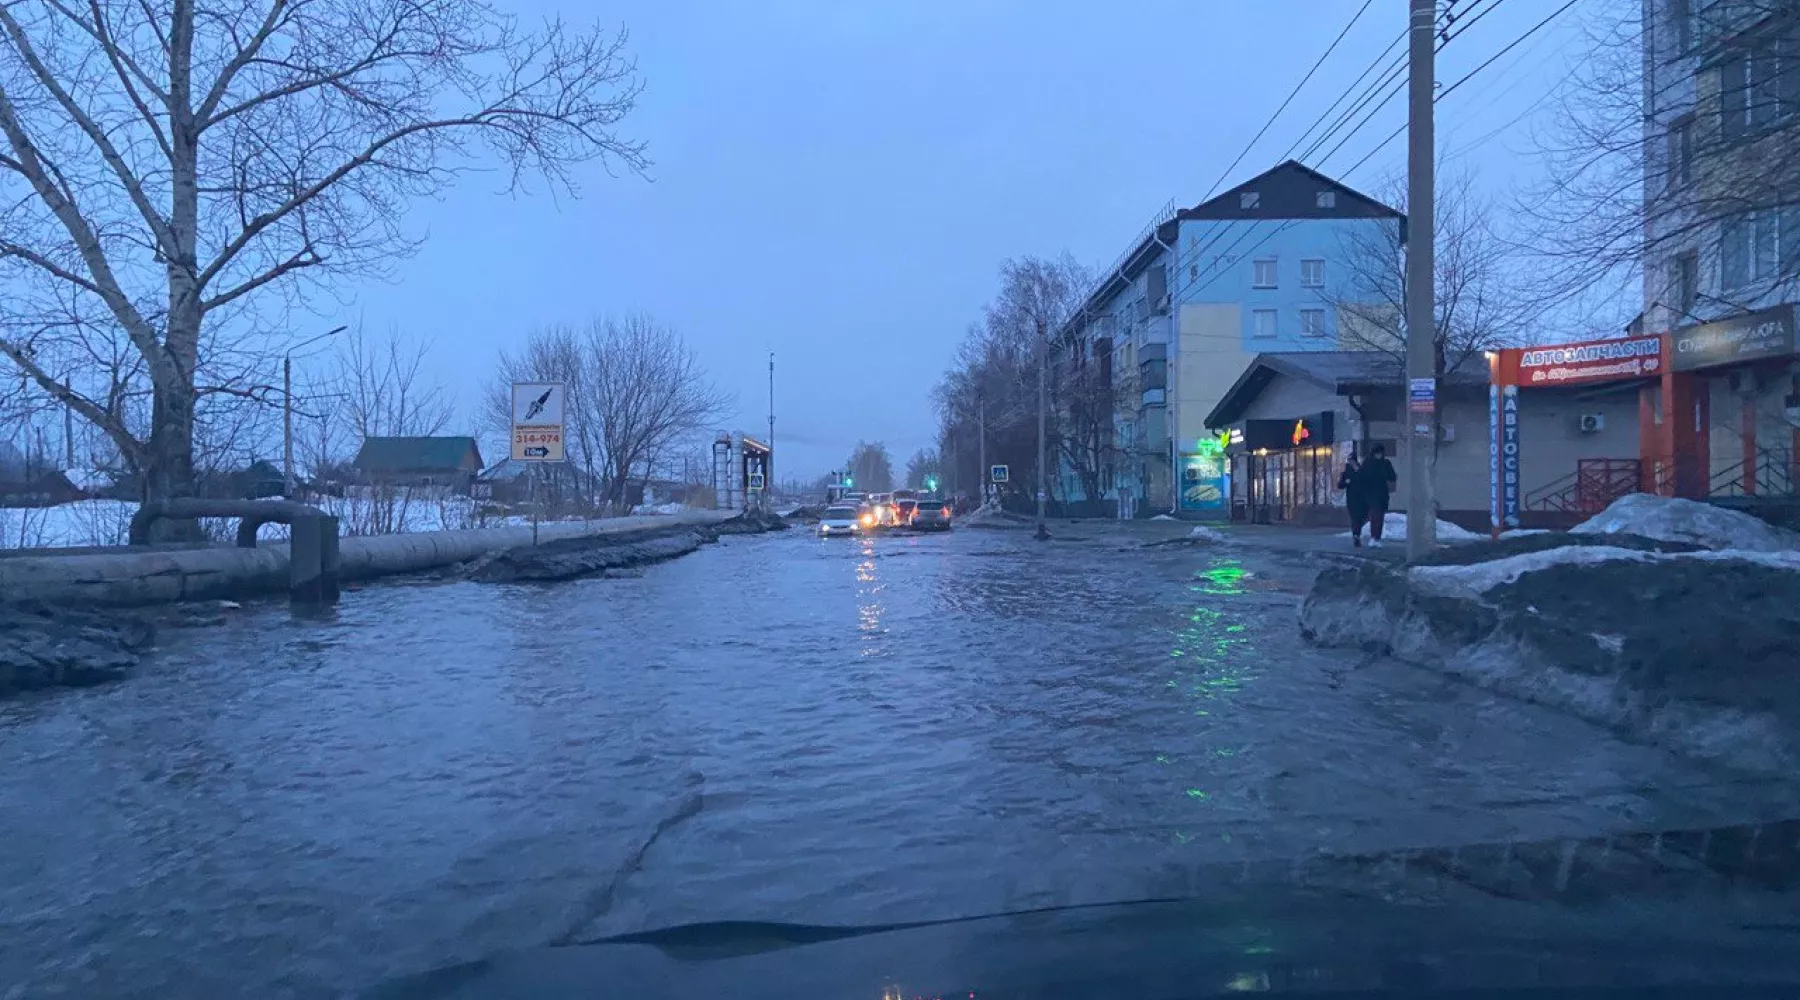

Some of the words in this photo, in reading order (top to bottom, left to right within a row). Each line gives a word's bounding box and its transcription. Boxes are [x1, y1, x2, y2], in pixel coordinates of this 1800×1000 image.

[1519, 338, 1660, 367] АВТОЗАПЧАСТИ
[516, 435, 559, 443] 314-974
[1504, 398, 1517, 514] АВТОСВЕТ
